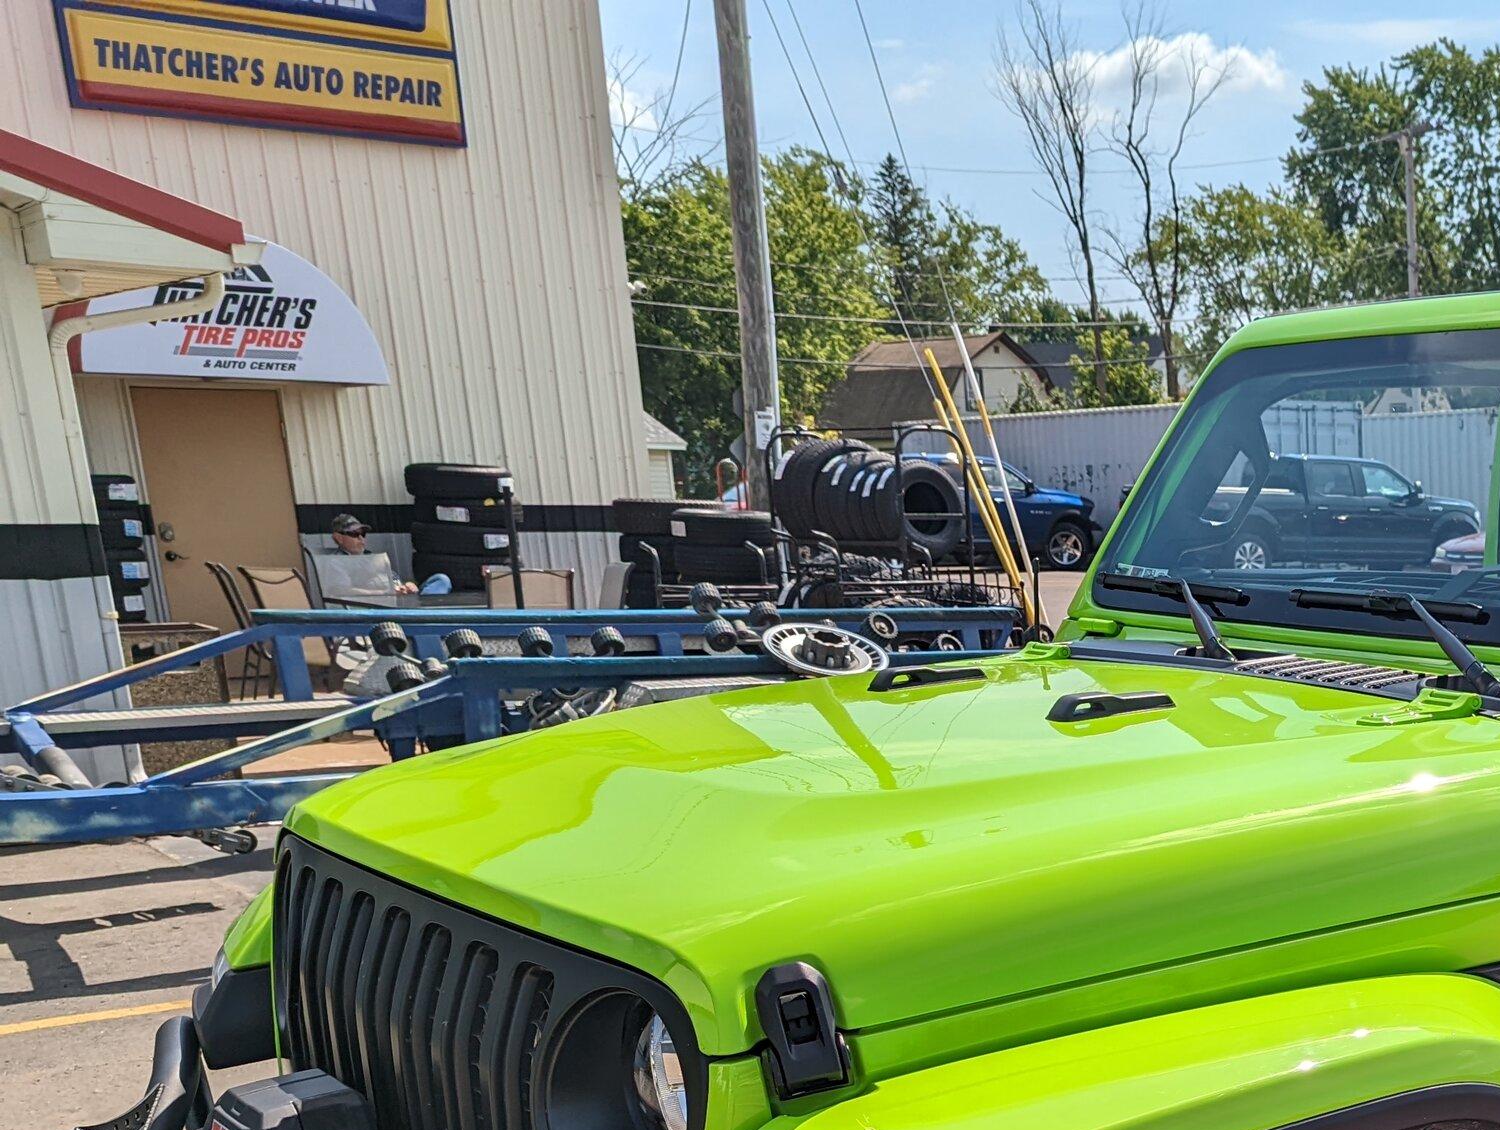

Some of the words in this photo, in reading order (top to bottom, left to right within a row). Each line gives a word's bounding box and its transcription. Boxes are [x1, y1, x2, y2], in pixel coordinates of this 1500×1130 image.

[94, 38, 264, 87] THATCHER'S
[274, 62, 343, 96] AUTO
[353, 71, 442, 108] REPAIR
[179, 325, 237, 355] TIRE
[236, 329, 306, 358] PROS
[203, 359, 212, 369] &
[214, 360, 246, 370] AUTO
[250, 361, 296, 372] CENTER
